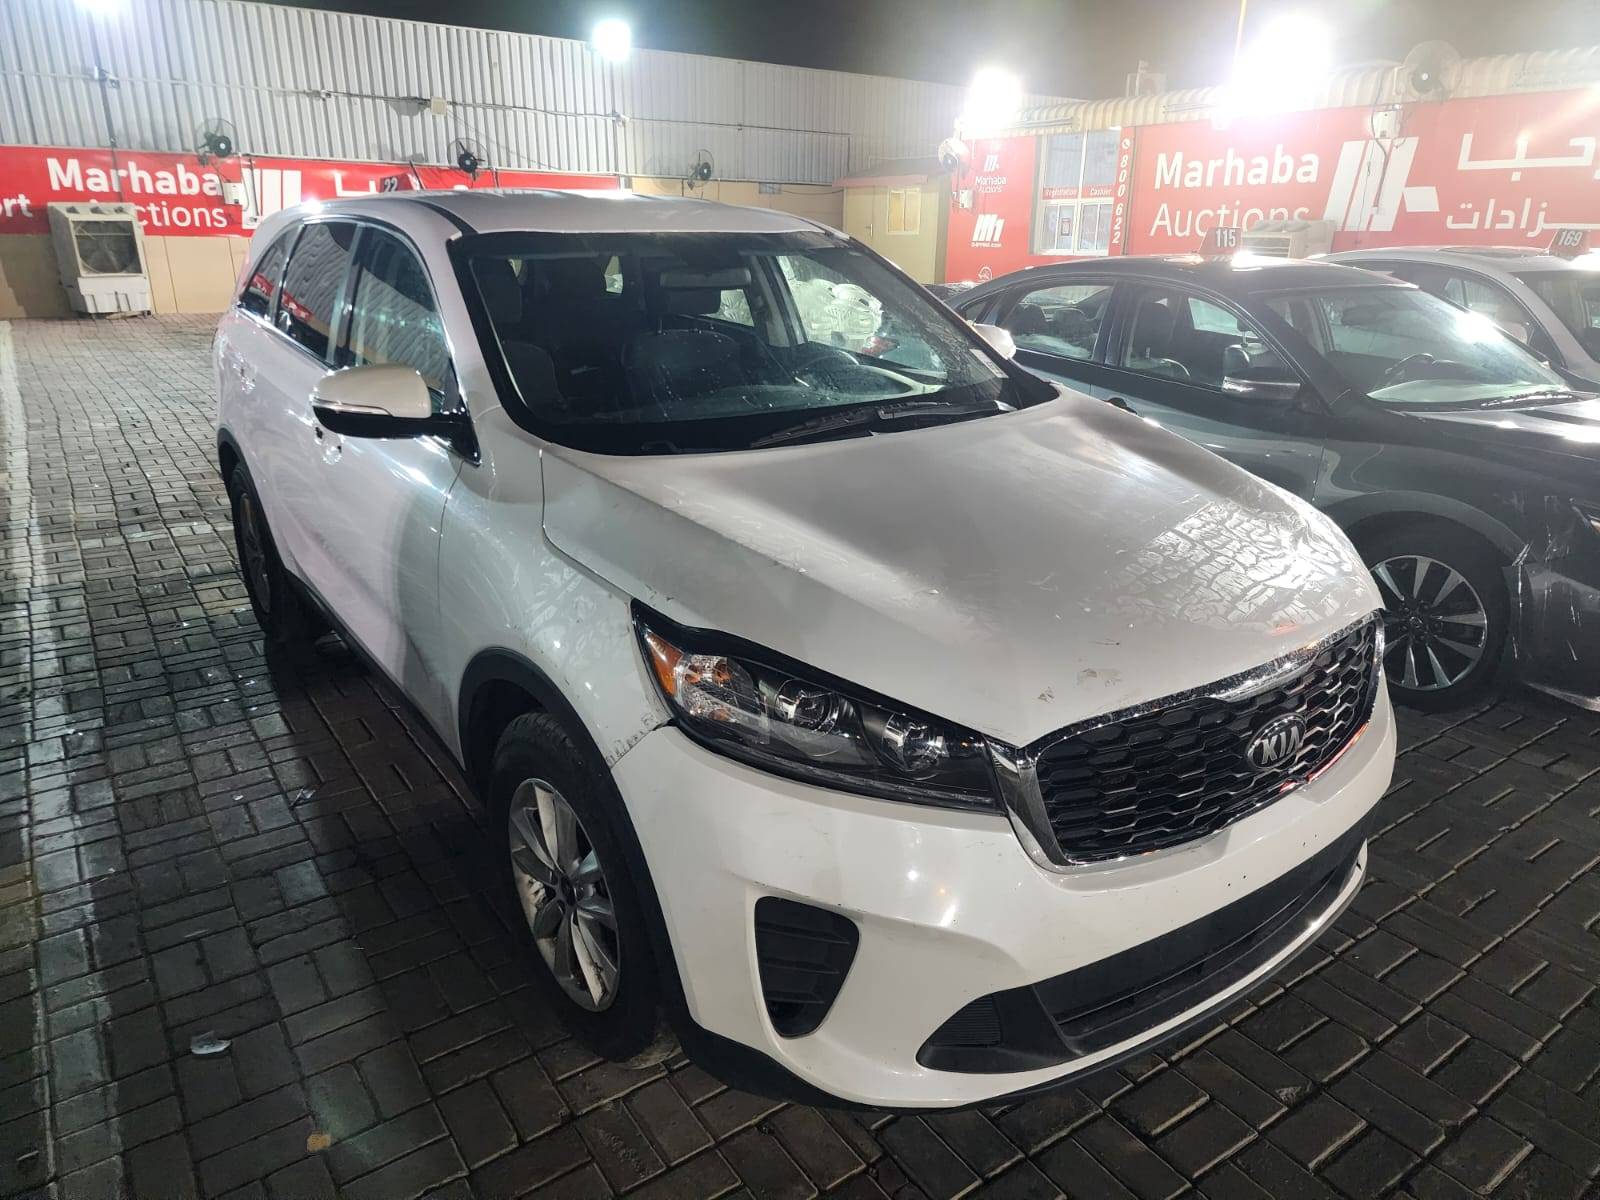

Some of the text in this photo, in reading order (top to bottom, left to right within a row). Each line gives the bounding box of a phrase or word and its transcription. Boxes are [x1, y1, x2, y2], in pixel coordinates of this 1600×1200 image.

[1154, 144, 1319, 189] Marhaba
[1458, 133, 1600, 181] حبا
[46, 157, 222, 197] Marhaba
[383, 177, 398, 192] 22
[975, 175, 1007, 185] Marhaba
[135, 201, 228, 228] ctions
[1111, 154, 1129, 244] 800 622
[1215, 228, 1236, 249] 115
[1558, 231, 1583, 246] 169
[1261, 726, 1300, 764] KIA
